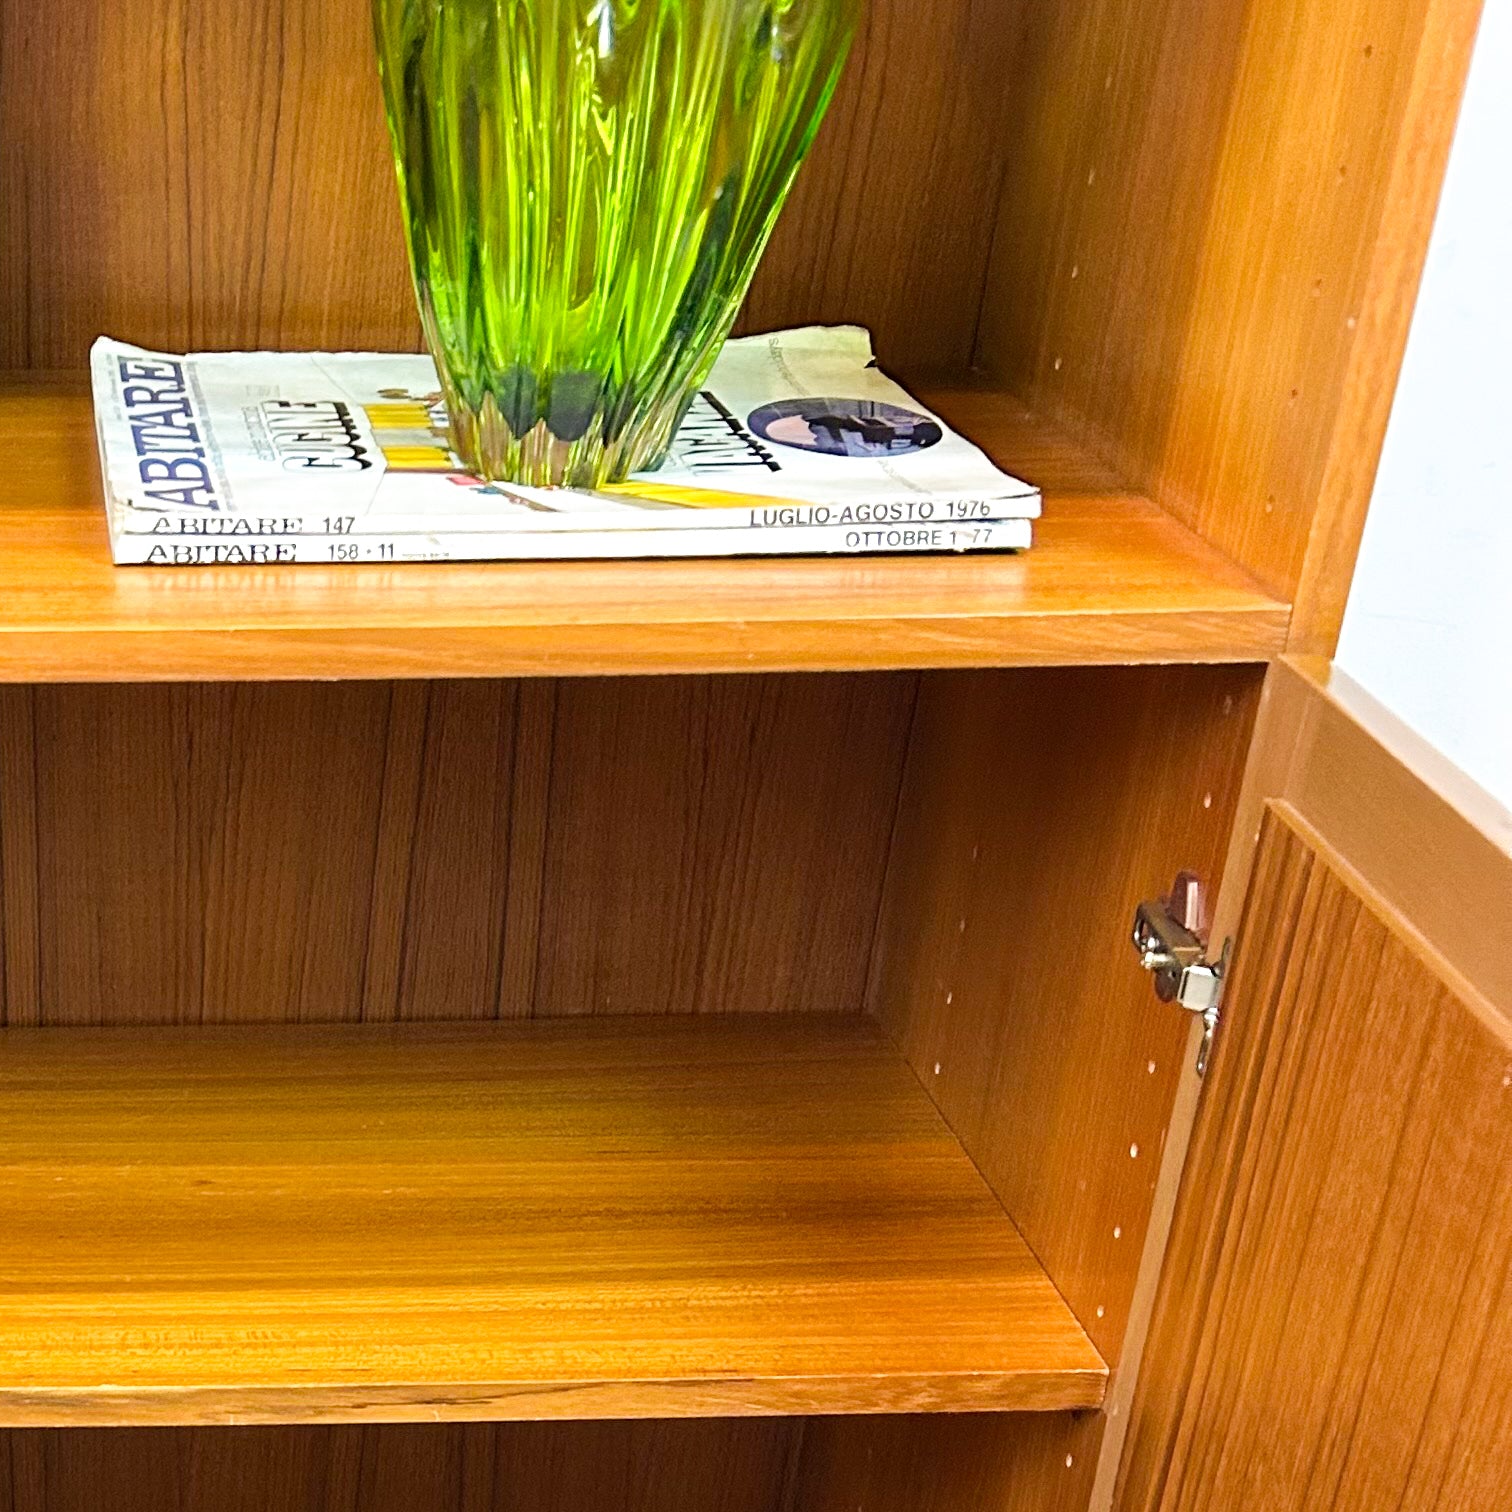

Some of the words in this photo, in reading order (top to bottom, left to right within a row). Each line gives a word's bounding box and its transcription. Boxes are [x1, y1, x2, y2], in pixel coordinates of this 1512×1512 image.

[117, 354, 220, 511] ABITARE
[749, 501, 935, 527] LUGLIO-AGOSTO
[946, 499, 991, 518] 1976
[151, 517, 303, 535] ABITARE
[322, 516, 356, 535] 147
[845, 529, 942, 547] OTTOBRE
[144, 543, 297, 563] ABITARE
[327, 543, 359, 560] 158
[378, 542, 395, 560] 11
